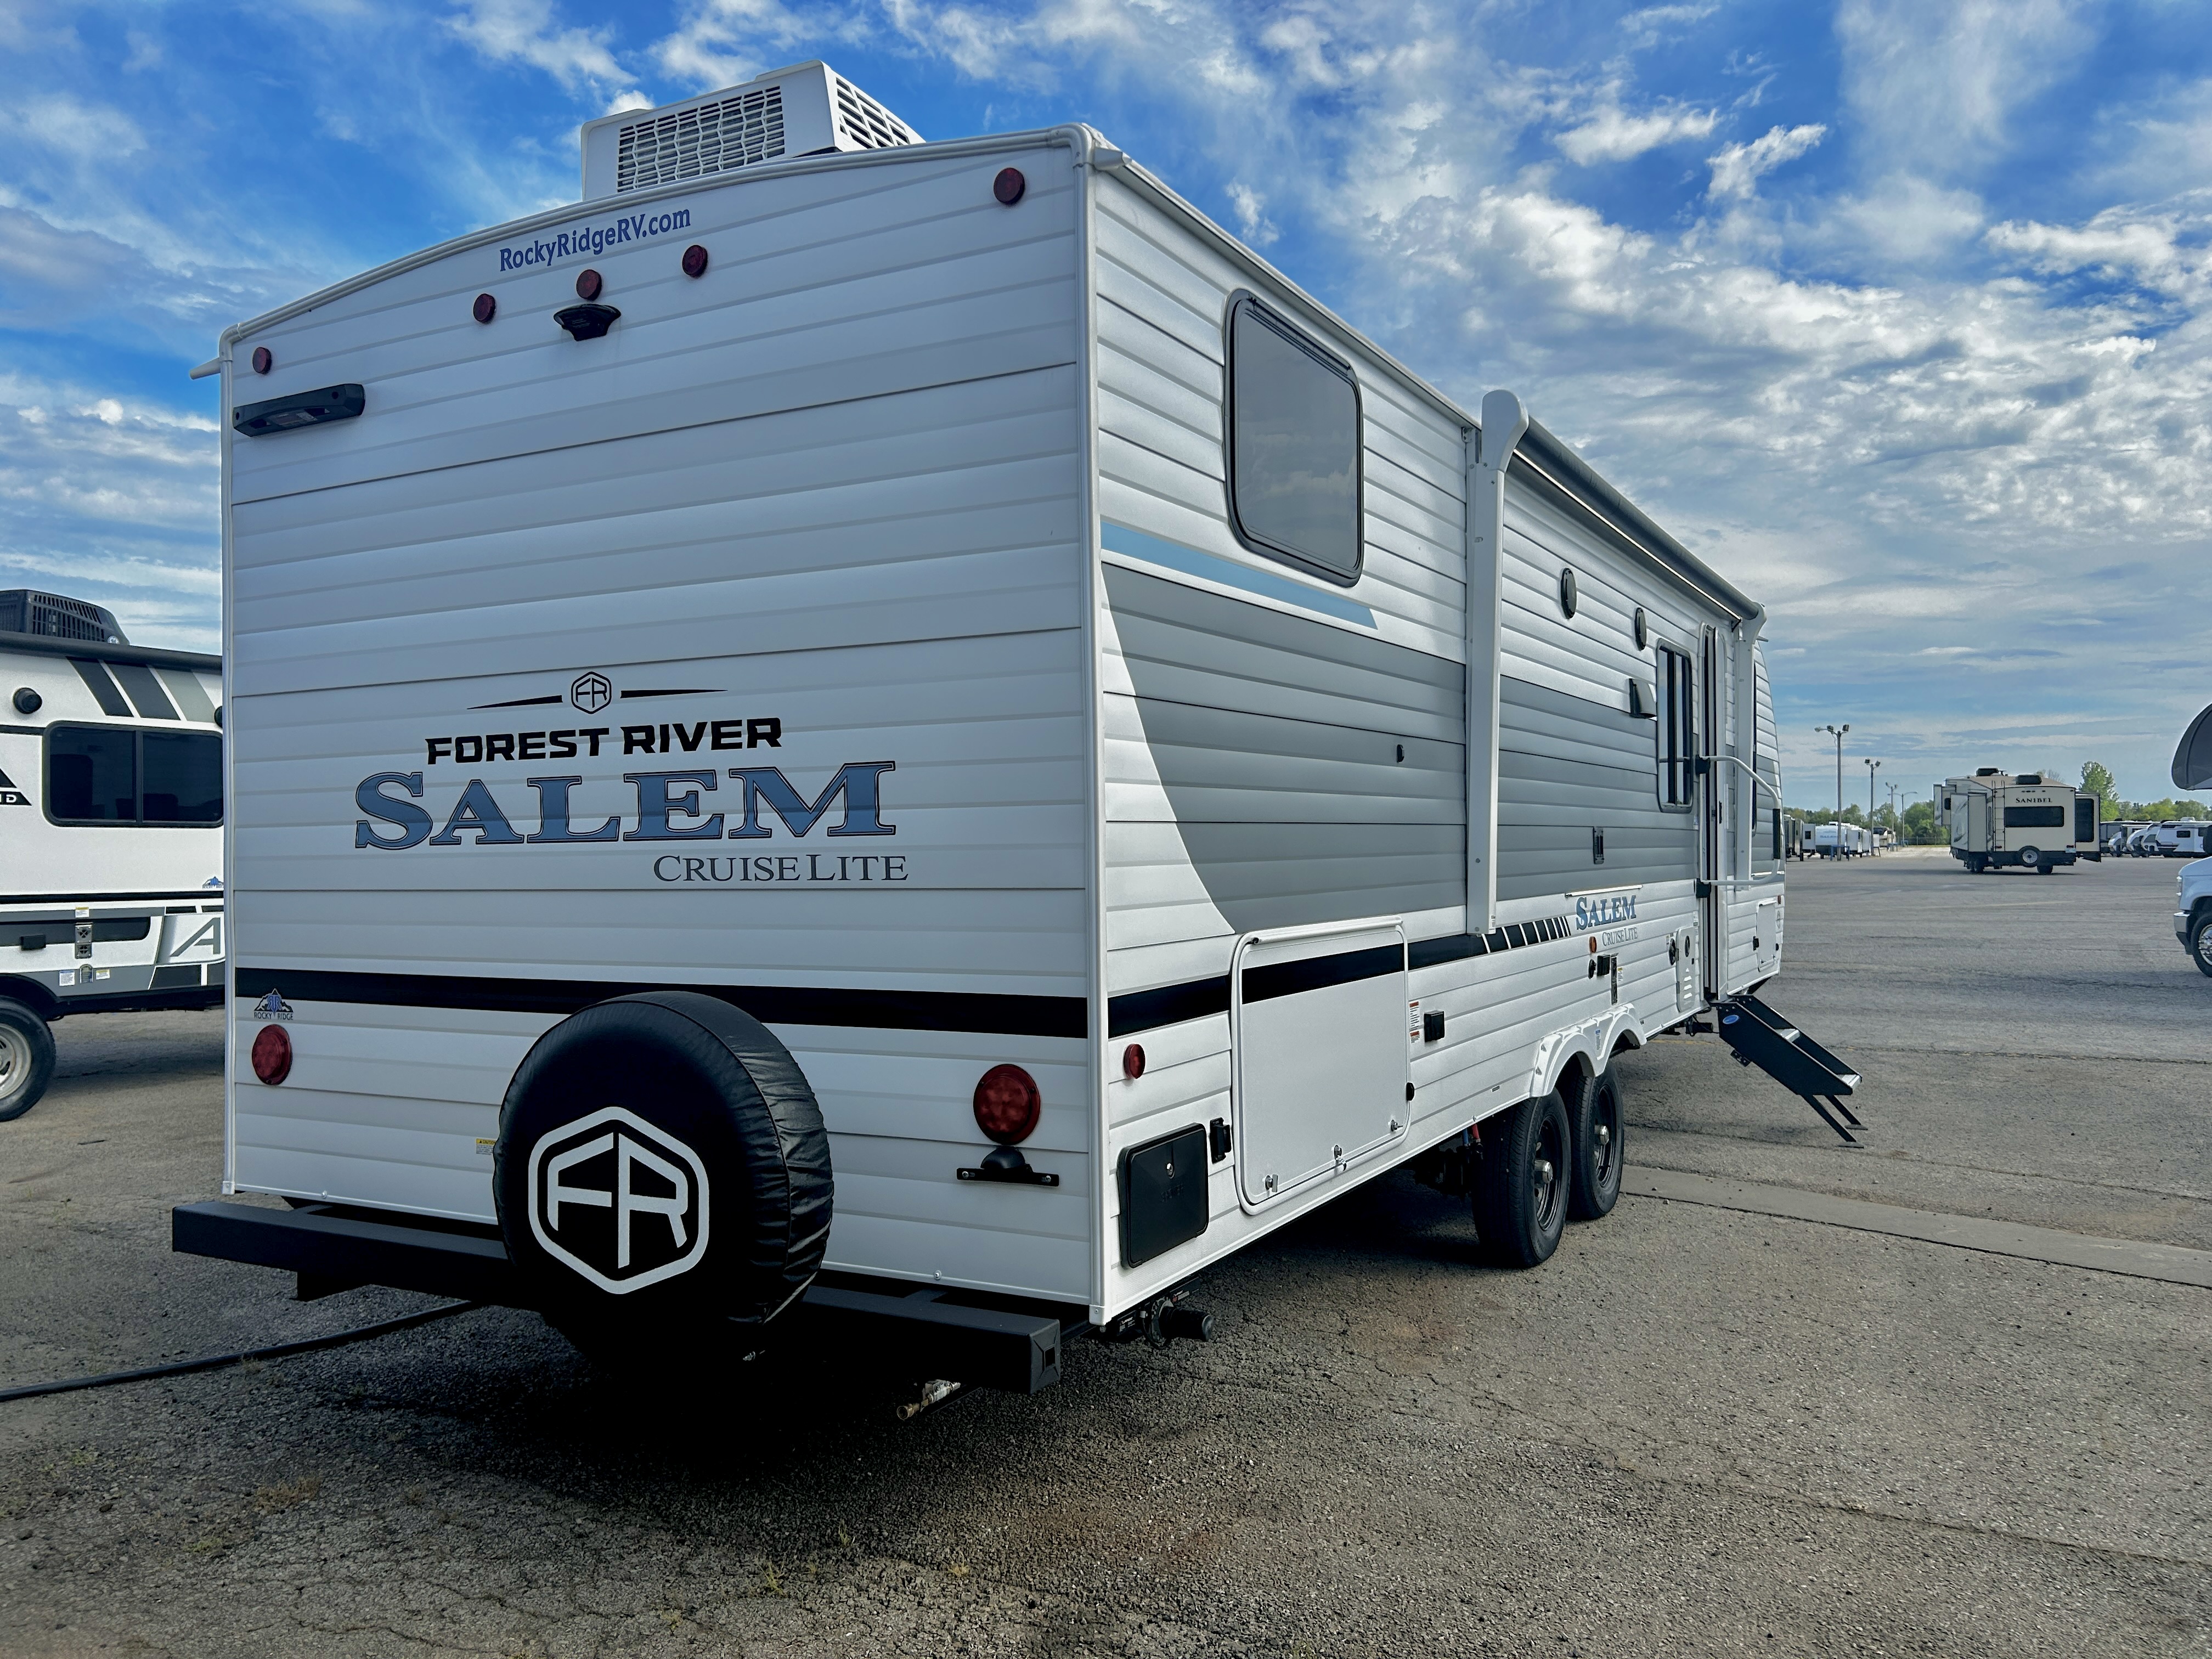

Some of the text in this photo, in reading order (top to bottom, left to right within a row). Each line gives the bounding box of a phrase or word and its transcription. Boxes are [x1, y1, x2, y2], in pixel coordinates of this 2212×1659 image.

[500, 208, 691, 272] RockyRidgeRV.com
[425, 717, 782, 765] FOREST RIVER
[354, 760, 895, 850] SALEM
[1575, 894, 1637, 930] SALEM
